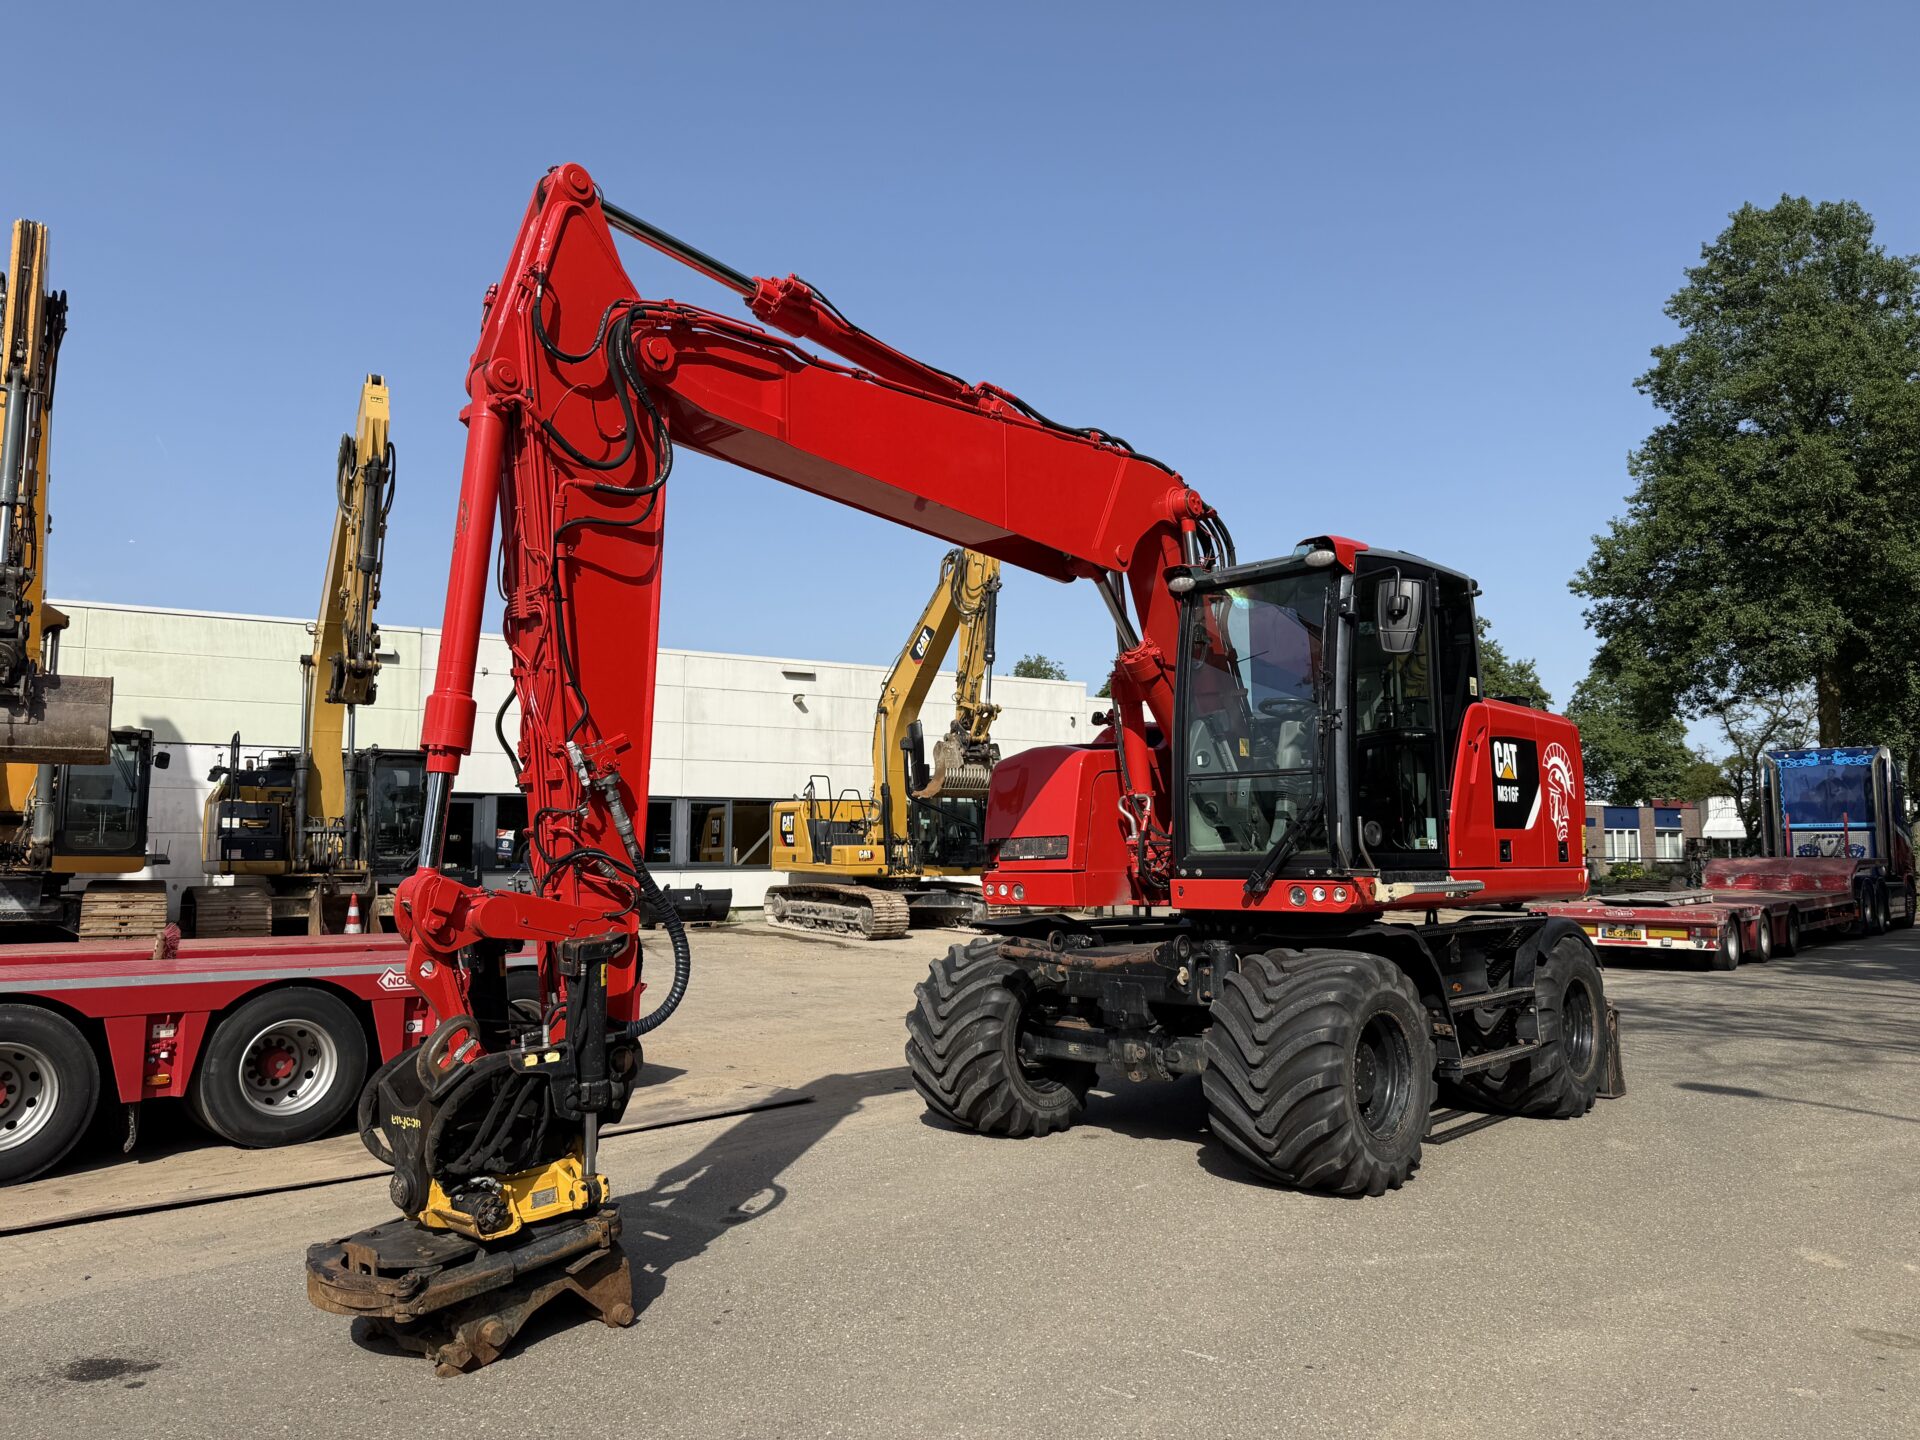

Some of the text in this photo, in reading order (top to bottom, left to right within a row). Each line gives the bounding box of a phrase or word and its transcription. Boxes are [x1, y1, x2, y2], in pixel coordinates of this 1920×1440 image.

[916, 629, 931, 657] CAT
[1493, 741, 1518, 779] CAT
[1497, 785, 1520, 803] M316F
[782, 815, 794, 831] CAT
[859, 850, 871, 858] CAT
